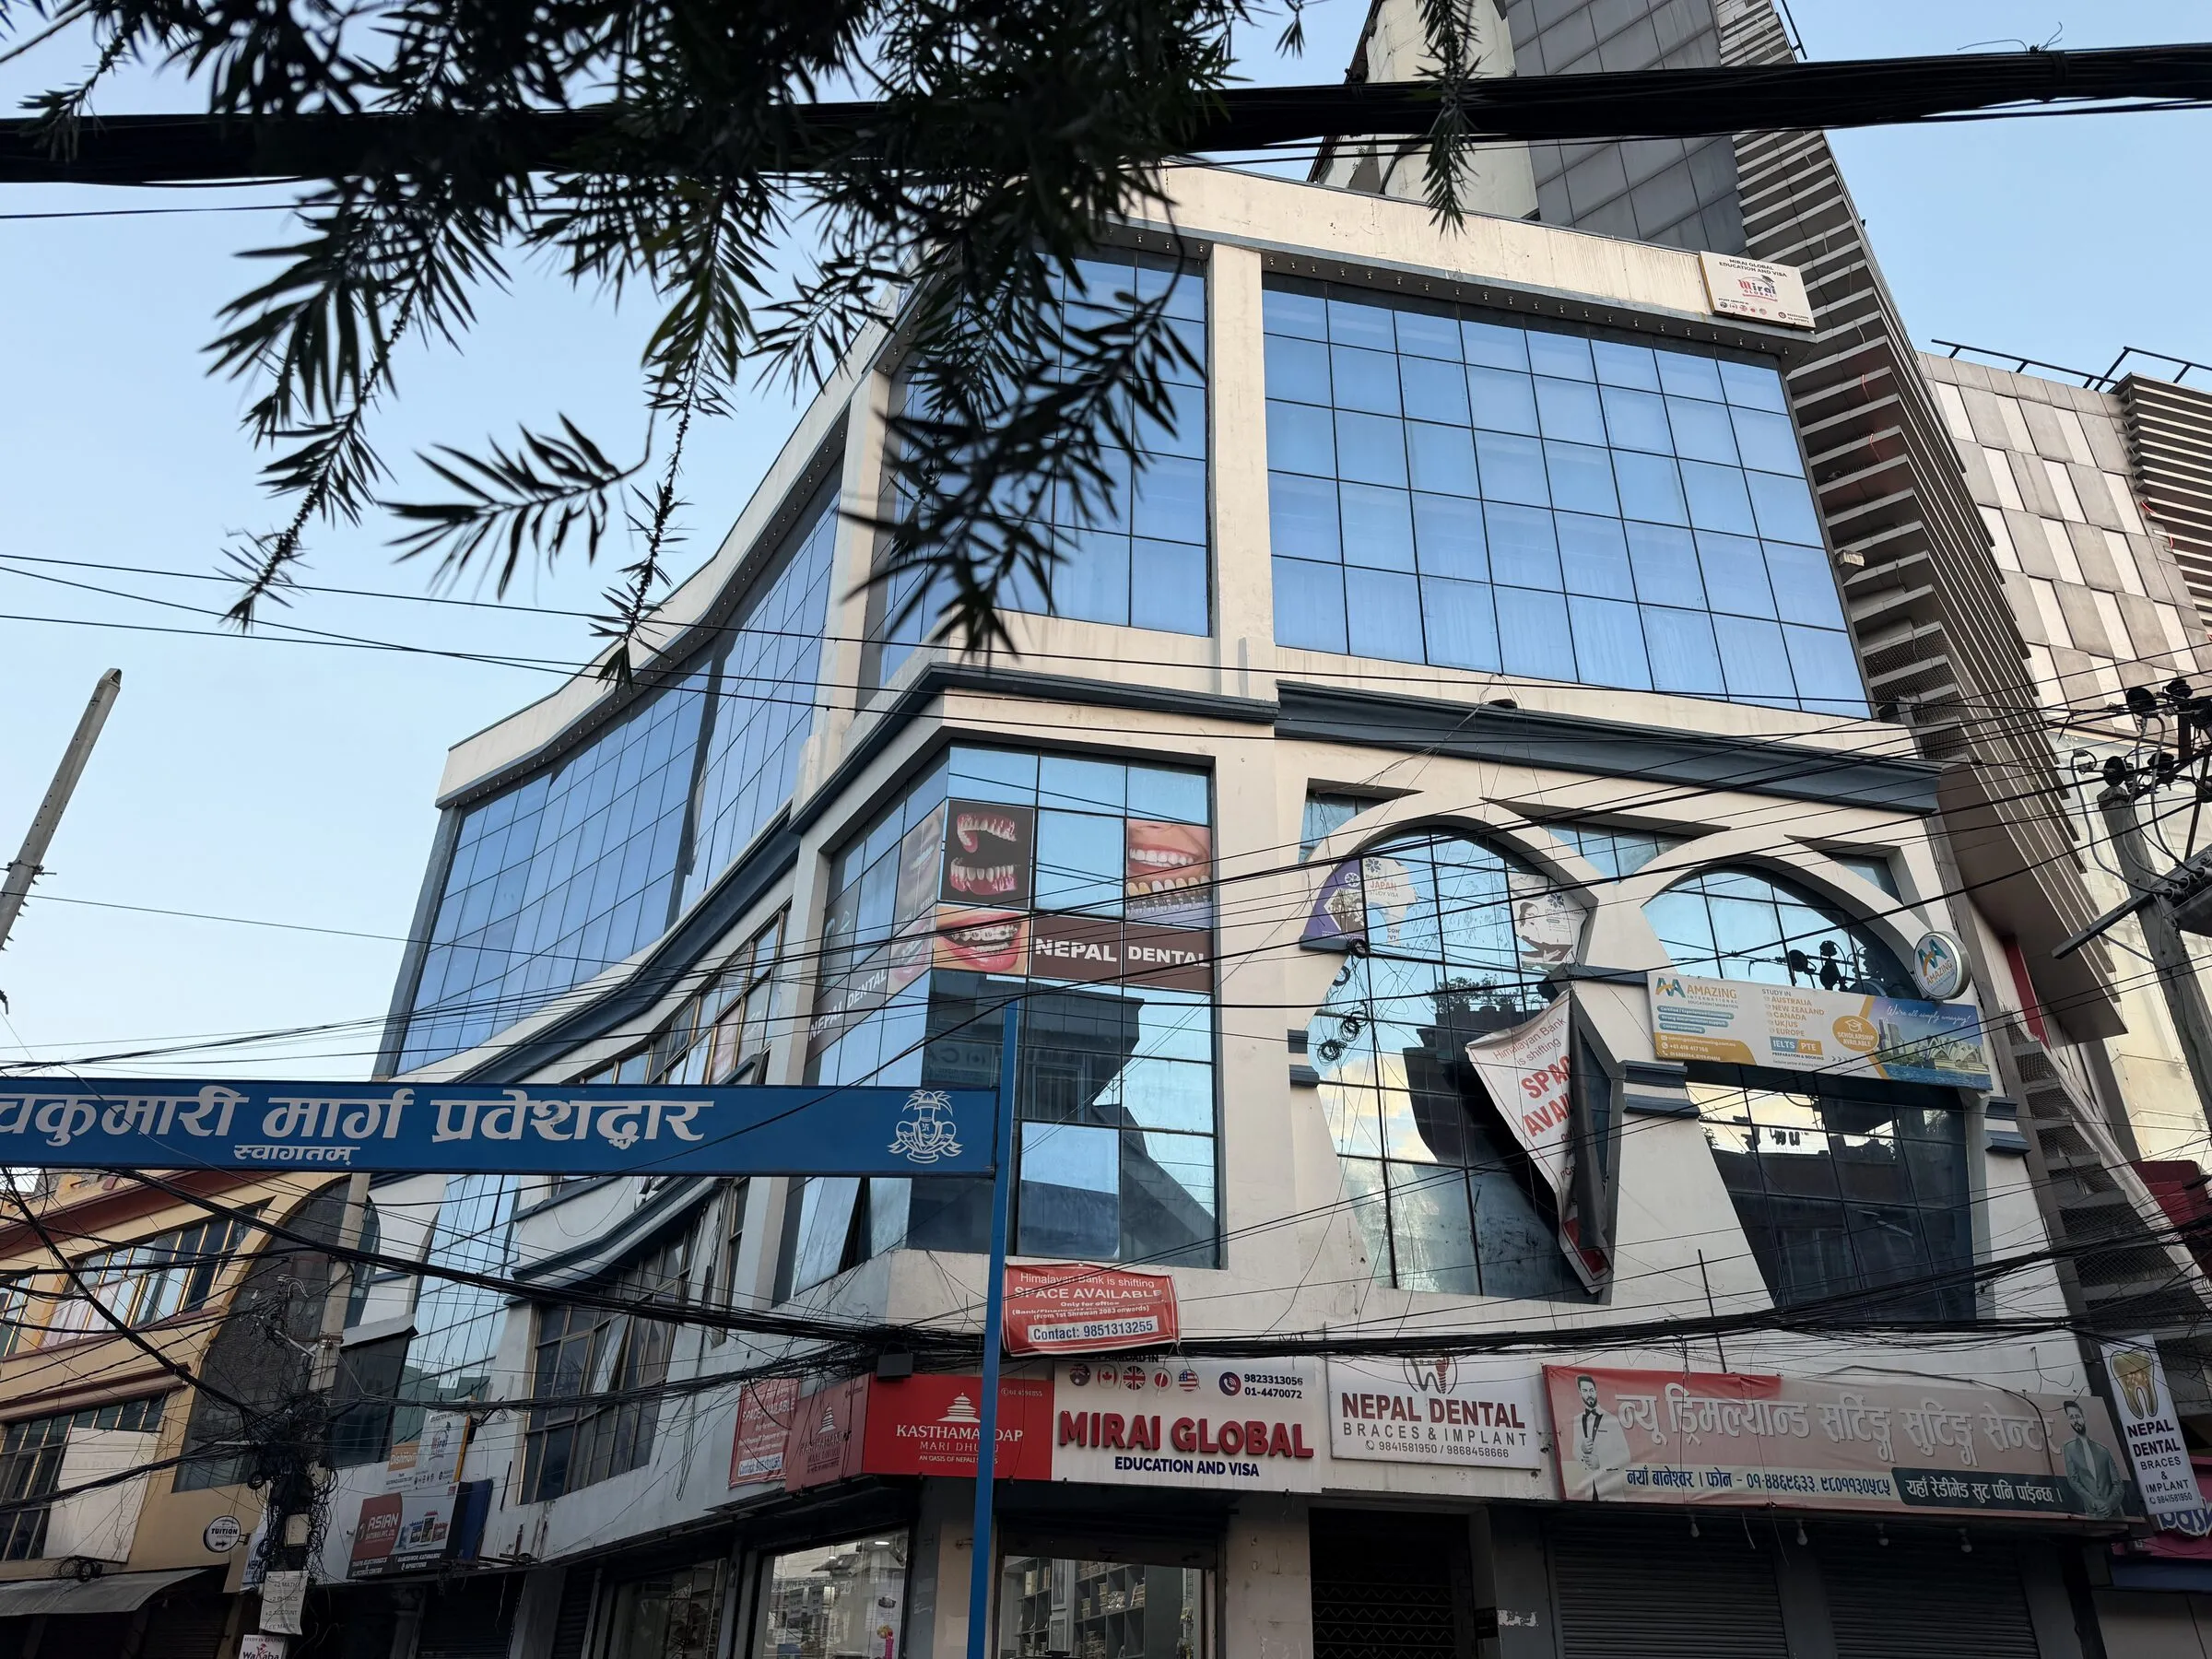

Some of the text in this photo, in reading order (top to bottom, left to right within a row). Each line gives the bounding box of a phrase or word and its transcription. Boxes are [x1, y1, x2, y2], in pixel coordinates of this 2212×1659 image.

[1719, 262, 1757, 272] EDUCATION
[1728, 259, 1774, 271] MIRAI GLOBAL
[1035, 938, 1210, 968] NEPAL DENTAL
[1926, 960, 1953, 985] AMAZING
[1687, 984, 1737, 999] AMAZING
[809, 1000, 843, 1041] NEPAL
[846, 969, 887, 1009] DENTAL
[1771, 996, 1812, 1006] AUSTRALIA
[1773, 1012, 1806, 1021] CANADA
[1791, 1006, 1825, 1016] ZEALAND
[1493, 1018, 1567, 1060] Himalayan Bank
[1776, 1028, 1806, 1037] EUROPE
[1837, 1031, 1875, 1041] SCHOLARSHIP
[1772, 1040, 1817, 1052] IELTS PTE
[1842, 1039, 1872, 1047] AVAILABLE
[1516, 1038, 1562, 1066] is shifting
[262, 1088, 415, 1139] मार्ग
[430, 1088, 714, 1150] प्रवेशद्वार
[233, 1145, 361, 1166] स्वागतम्
[1020, 1272, 1155, 1288] Himalayan Bank is shifting
[1015, 1286, 1163, 1300] SPACE AVAILABLE
[1033, 1320, 1153, 1341] Contact: 9851313255
[1244, 1373, 1304, 1386] 9823313056
[1244, 1386, 1303, 1399] 01-4470072
[1341, 1393, 1526, 1429] NEPAL DENTAL
[896, 1424, 1023, 1442] KASTHAMADAP
[1615, 1394, 1668, 1445] न्यू
[1979, 1401, 2062, 1455] सेन्टर
[2127, 1419, 2175, 1439] NEPAL
[1059, 1410, 1315, 1458] MIRAI GLOBAL
[1343, 1422, 1526, 1446] BRACES & IMPLANT
[920, 1441, 950, 1452] MARI
[1379, 1441, 1438, 1453] 9841581950
[1447, 1445, 1509, 1458] 9868458666
[2132, 1438, 2181, 1458] DENTAL
[1114, 1456, 1260, 1477] EDUCATION AND VISA
[2140, 1456, 2182, 1471] BRACES
[1626, 1464, 1649, 1487] नयाँ
[1652, 1465, 1693, 1488] बानेश्वर
[1705, 1467, 1733, 1488] फोन
[2161, 1471, 2169, 1480] &
[1905, 1475, 1929, 1498] यहाँ
[1930, 1477, 1969, 1499] रेडीमेड
[1971, 1482, 1991, 1504] सुट
[1992, 1478, 2015, 1500] पनि
[2146, 1479, 2190, 1494] IMPLANT
[2157, 1494, 2193, 1504] 9841581950
[369, 1512, 399, 1529] ASIAN
